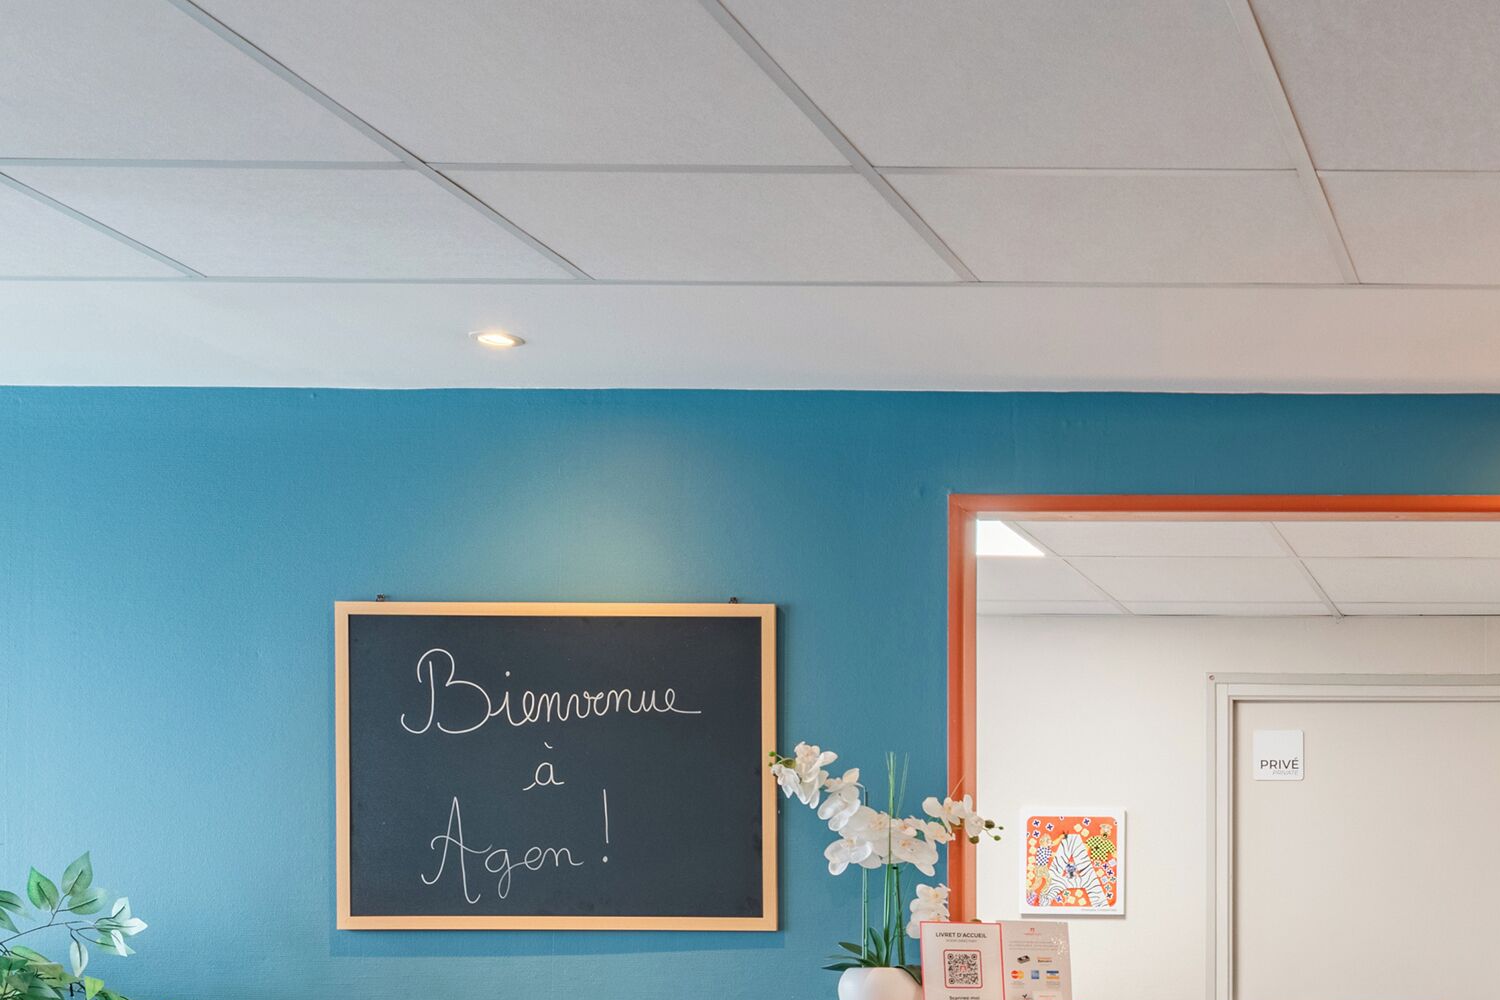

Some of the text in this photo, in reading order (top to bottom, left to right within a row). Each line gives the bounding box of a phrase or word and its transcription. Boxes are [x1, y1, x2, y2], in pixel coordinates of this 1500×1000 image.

[400, 648, 702, 734] Bienvenue
[522, 741, 565, 791] à
[1260, 756, 1300, 770] PRIVÉ
[420, 788, 611, 904] Agen !
